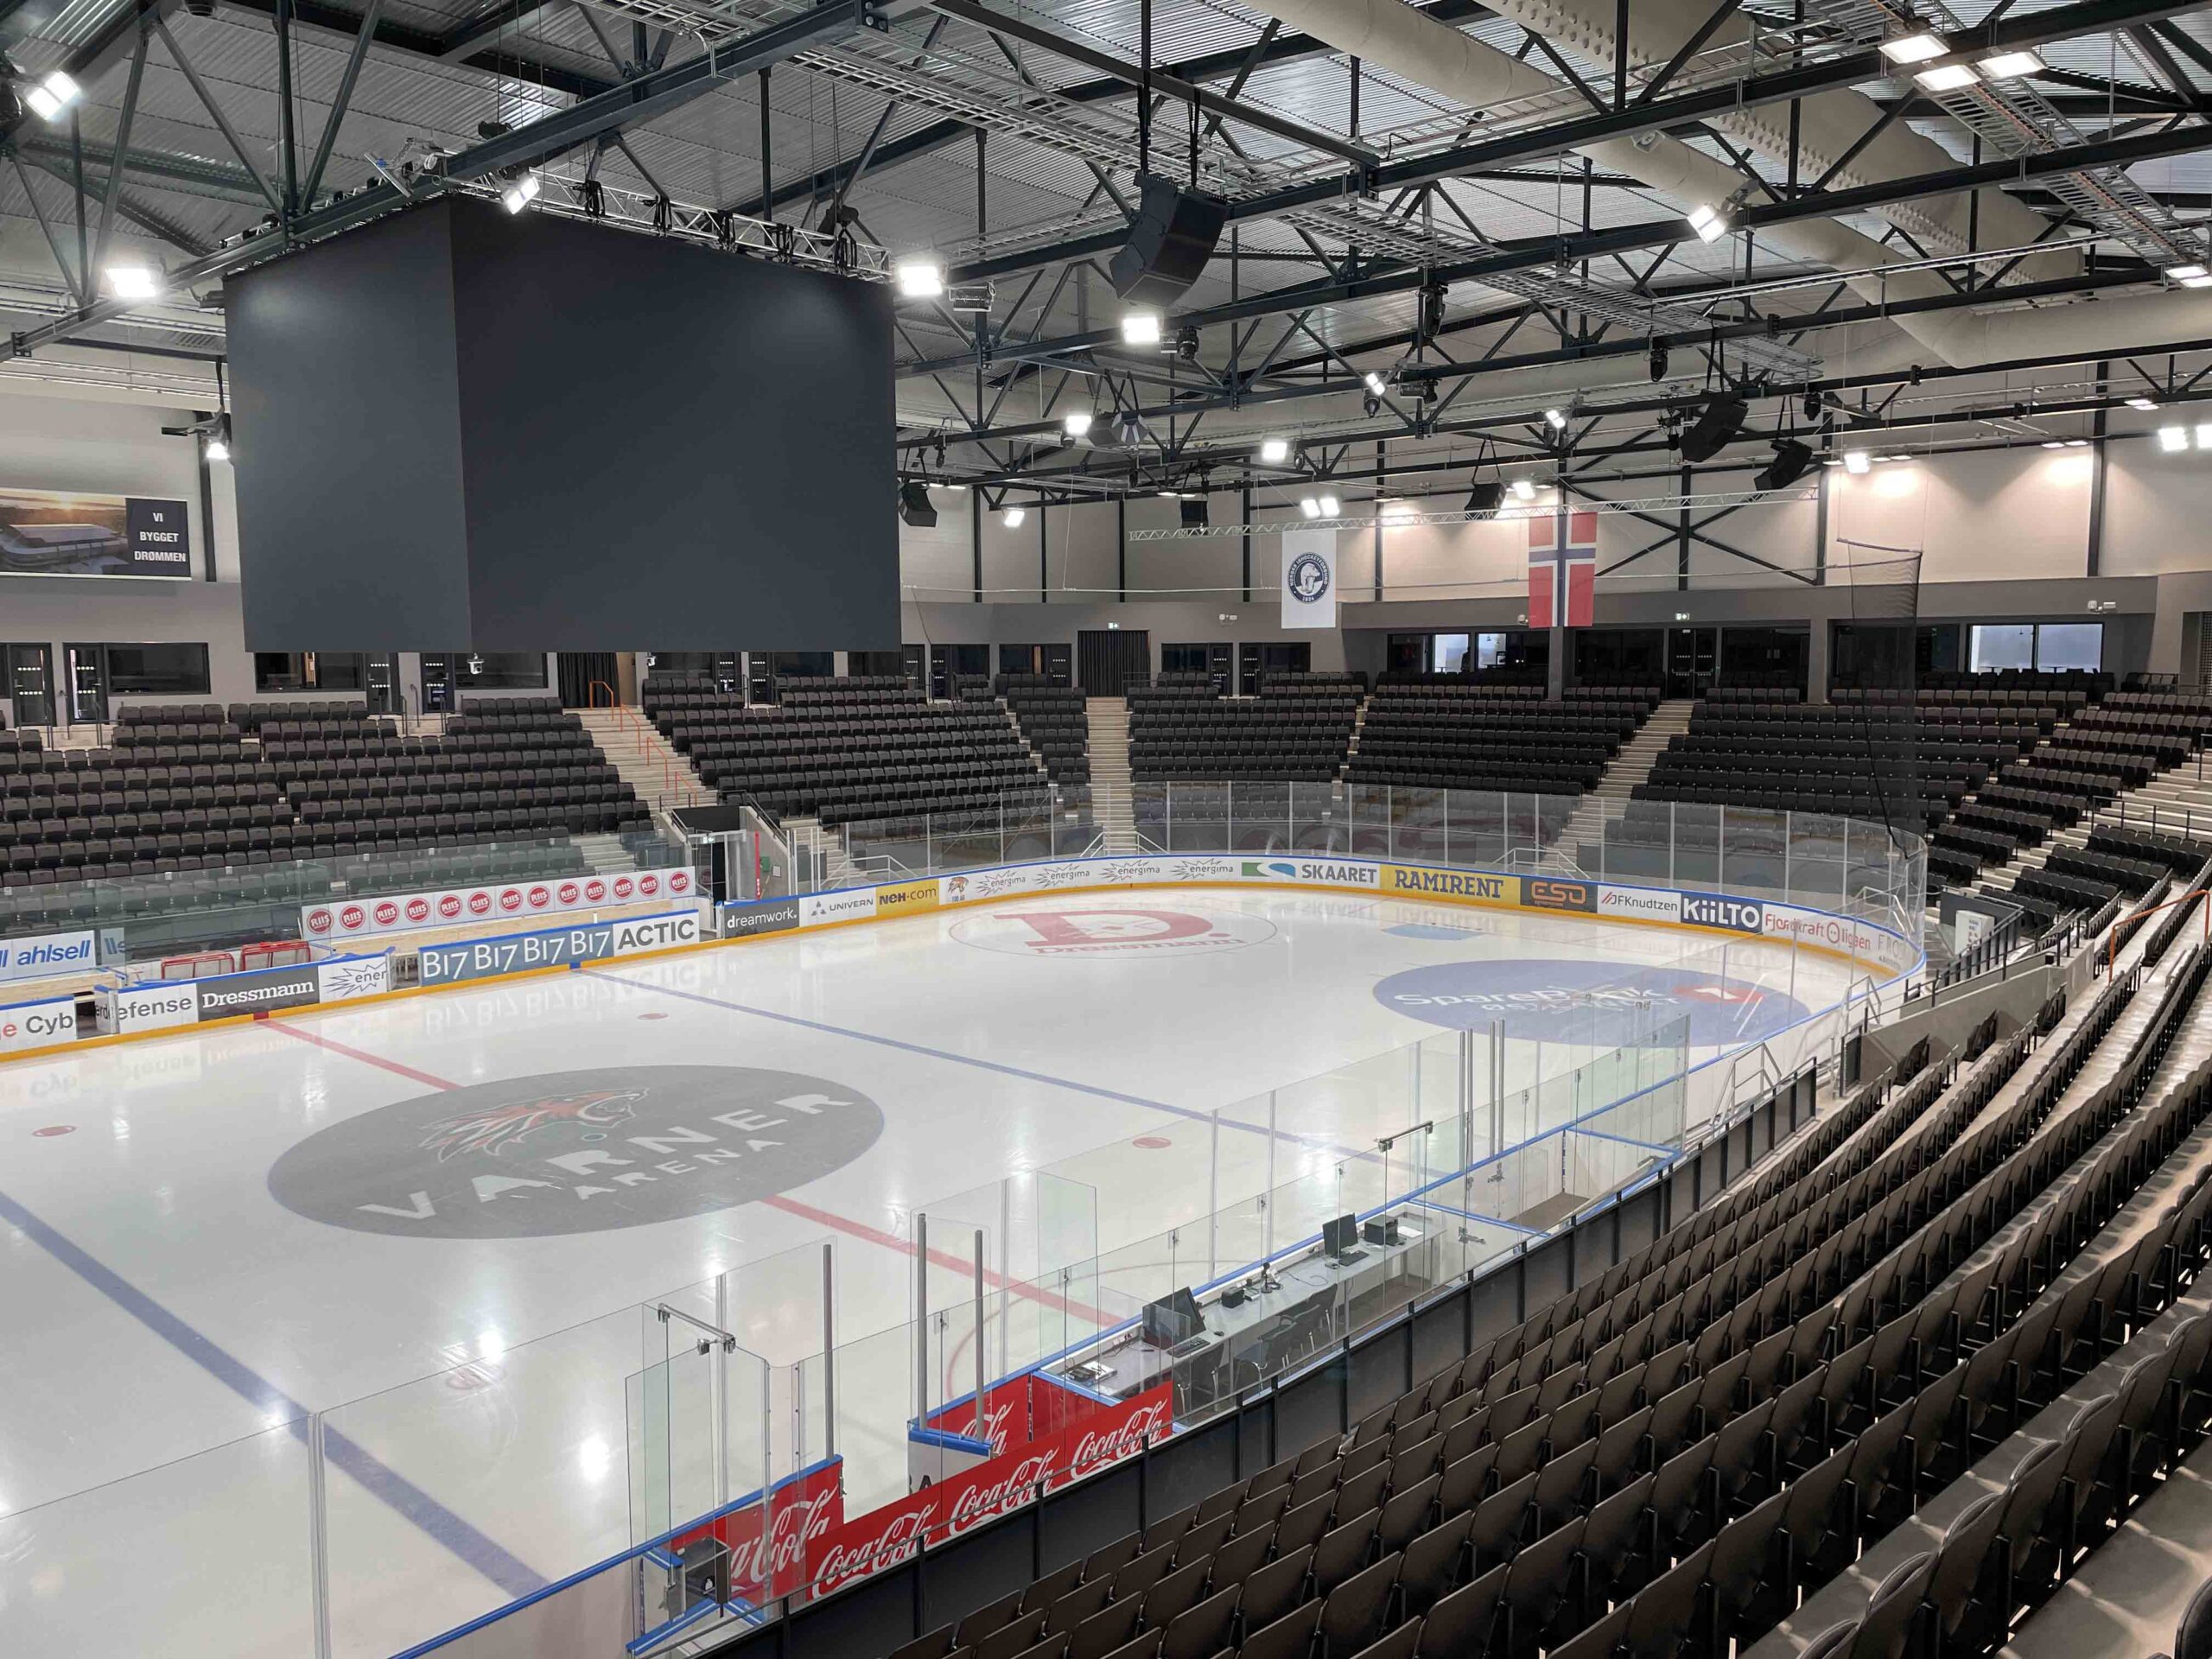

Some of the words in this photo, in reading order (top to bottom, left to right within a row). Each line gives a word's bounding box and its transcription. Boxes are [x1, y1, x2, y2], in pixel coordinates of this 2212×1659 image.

[152, 512, 163, 522] VI
[139, 531, 179, 543] BYGGET
[134, 550, 187, 563] DRØMMEN
[1051, 868, 1090, 880] energima
[1117, 865, 1160, 878] energima
[1189, 864, 1234, 876] energima
[1301, 864, 1377, 884] SKAARET
[1395, 869, 1504, 899] RAMIRENT
[310, 915, 330, 928] RIIS
[344, 912, 361, 924] RIIS
[377, 907, 396, 919] RIIS
[409, 904, 427, 916] RIIS
[441, 901, 459, 912] RIIS
[471, 898, 488, 909] RIIS
[502, 893, 519, 906] RIIS
[531, 891, 548, 902] RIIS
[560, 888, 577, 899] RIIS
[587, 885, 604, 897] RIIS
[615, 882, 632, 893] RIIS
[641, 880, 657, 892] RIIS
[671, 876, 687, 888] RIIS
[830, 899, 874, 912] UNIVERN
[617, 919, 696, 950] ACTIC
[17, 940, 91, 965] ahlsell
[201, 980, 315, 1009] Dressmann
[26, 1012, 73, 1035] Cyb
[355, 1093, 855, 1221] VARNER
[575, 1138, 785, 1201] ARENA
